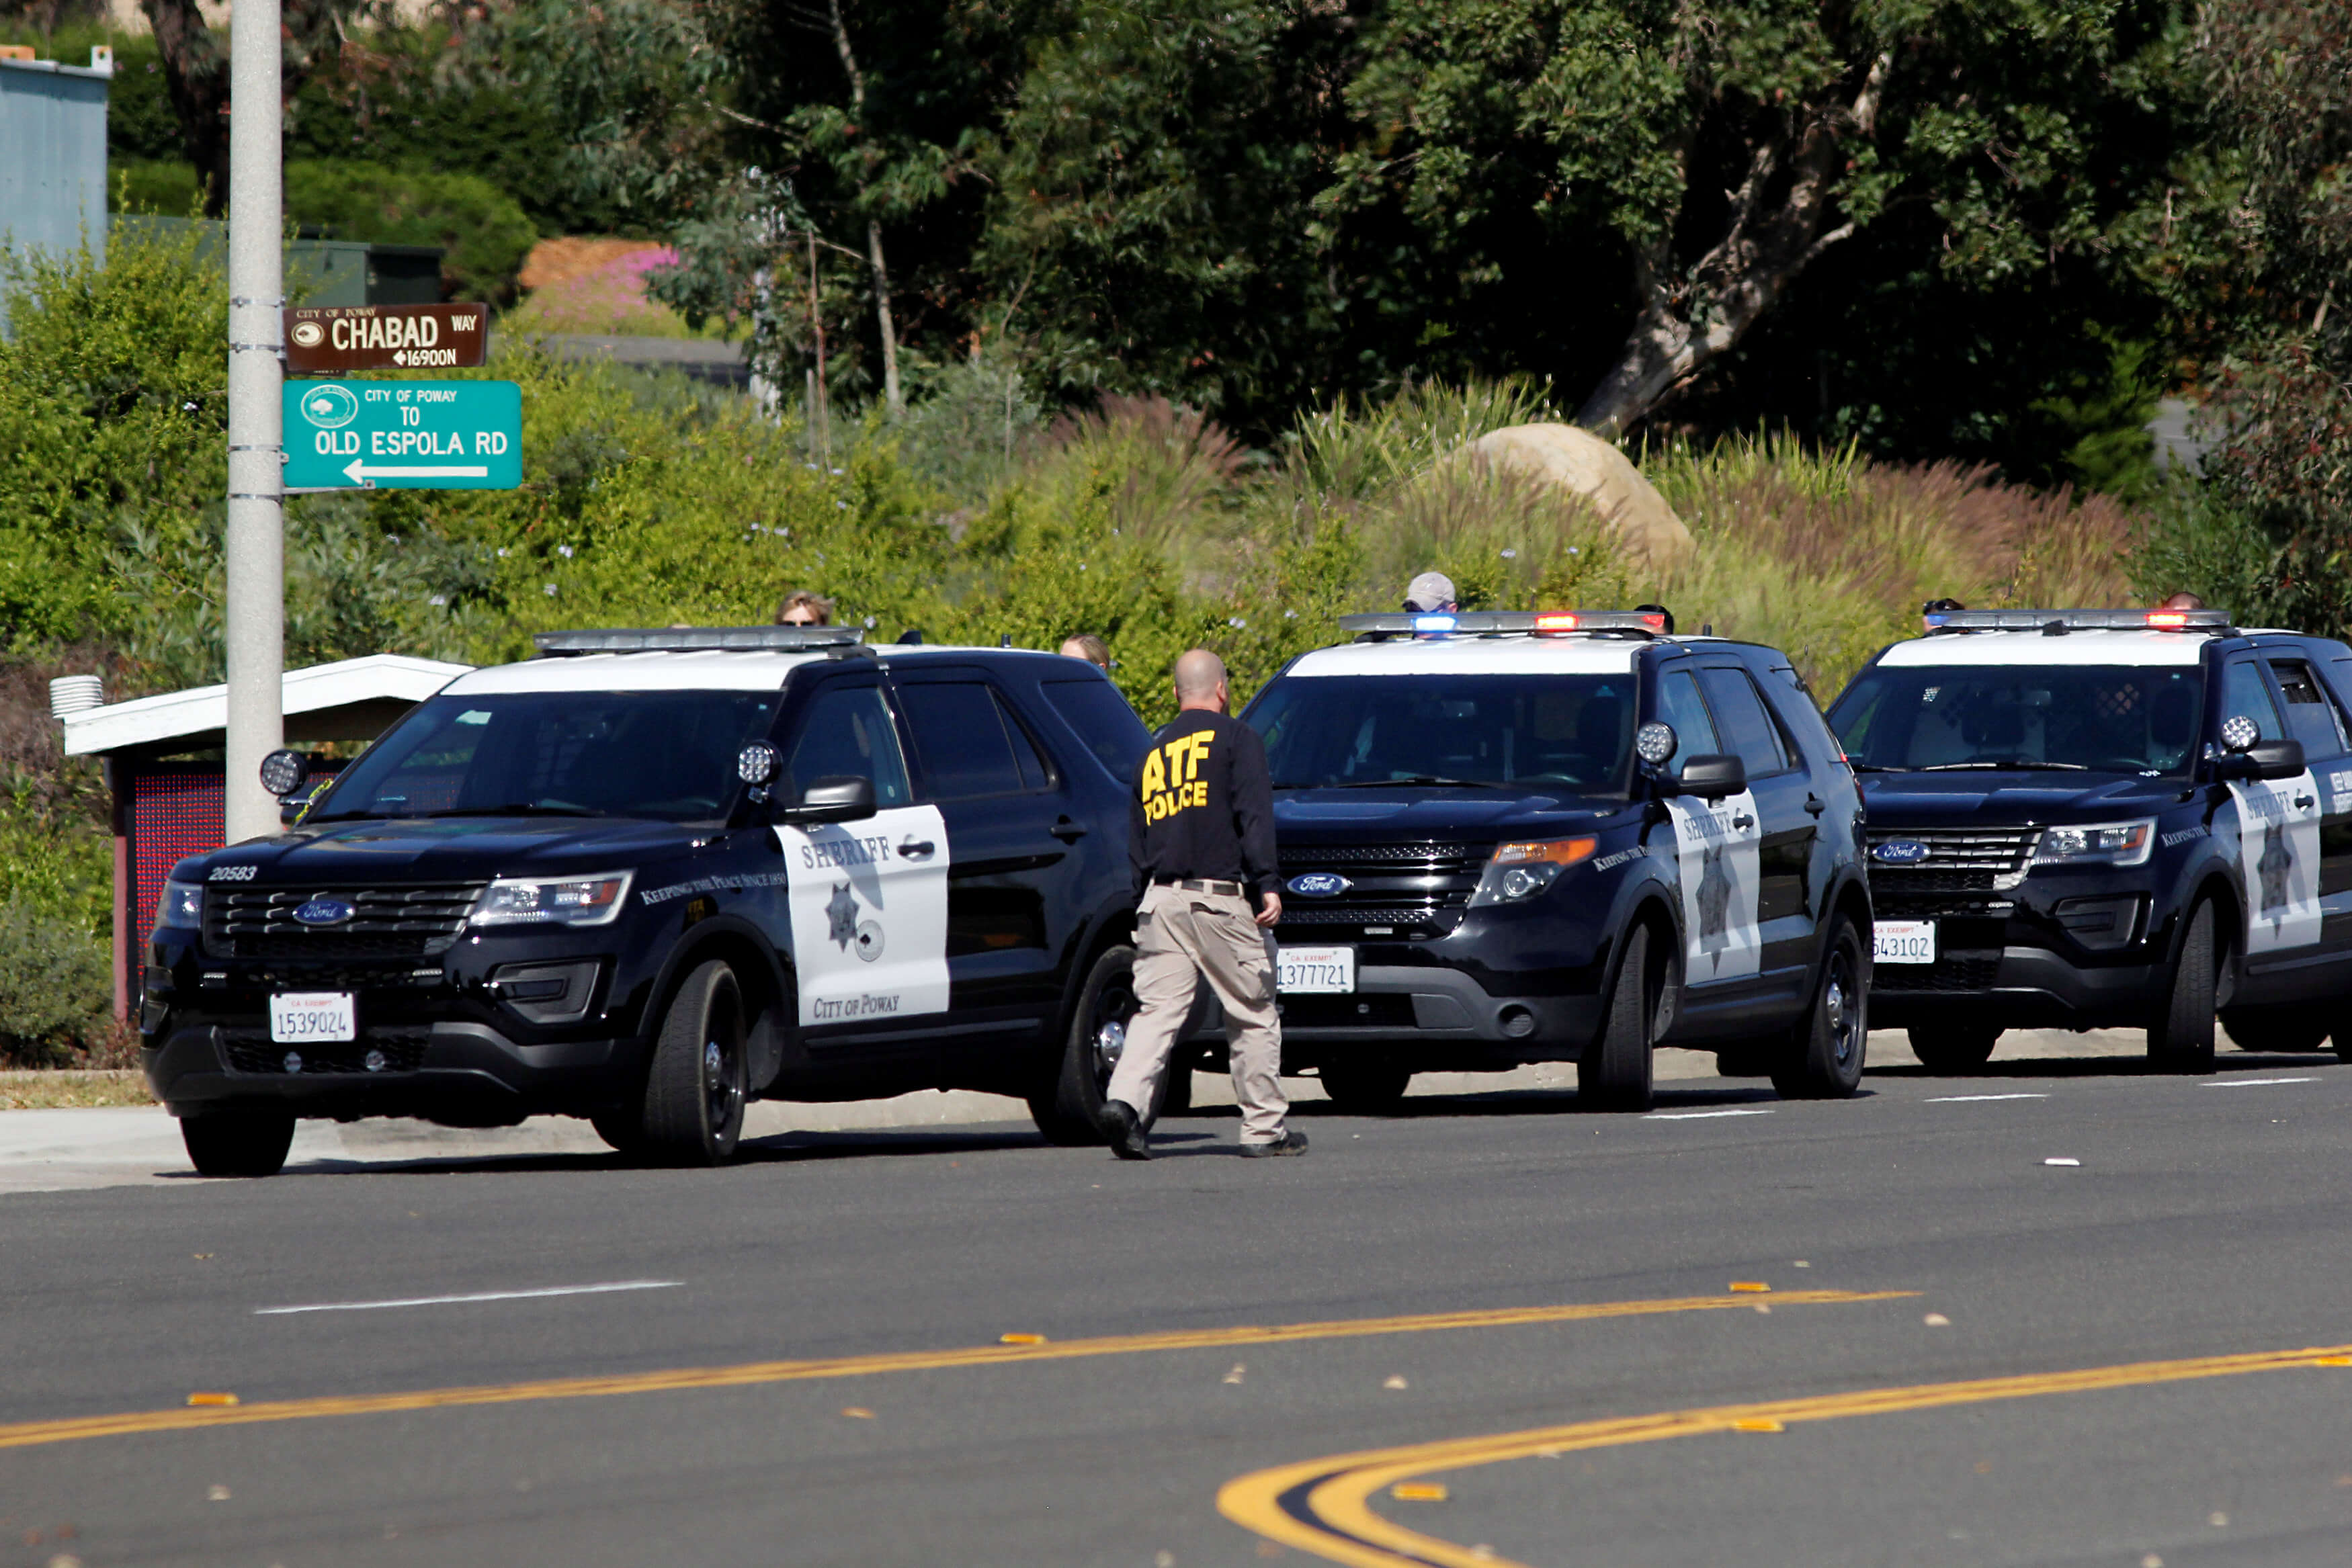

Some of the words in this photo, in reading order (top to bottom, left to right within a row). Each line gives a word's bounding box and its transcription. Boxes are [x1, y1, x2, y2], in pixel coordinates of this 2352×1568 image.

[296, 309, 320, 318] CITY
[325, 308, 339, 318] OF
[345, 307, 376, 318] POWAY
[332, 316, 437, 350] CHABAD
[451, 315, 477, 331] WAY
[407, 349, 456, 365] 16900N
[365, 390, 391, 402] CITY
[396, 390, 413, 402] OF
[417, 390, 457, 402] POWAY
[400, 406, 420, 426] TO
[315, 431, 361, 455] OLD
[372, 431, 464, 455] ESPOLA
[476, 432, 508, 455] RD
[1142, 730, 1215, 803] ATF
[1143, 781, 1208, 826] POLICE
[802, 836, 890, 869] SHERIFF
[1884, 844, 1917, 858] Ford
[208, 865, 258, 881] 20583
[1300, 875, 1337, 891] Ford
[640, 882, 693, 906] KEEPING
[692, 878, 715, 891] THE
[304, 903, 337, 918] Ford
[1277, 965, 1347, 985] 1377721
[814, 998, 843, 1018] CITY
[845, 999, 859, 1016] OF
[861, 994, 899, 1014] POWAY
[278, 1011, 347, 1034] 1539024
